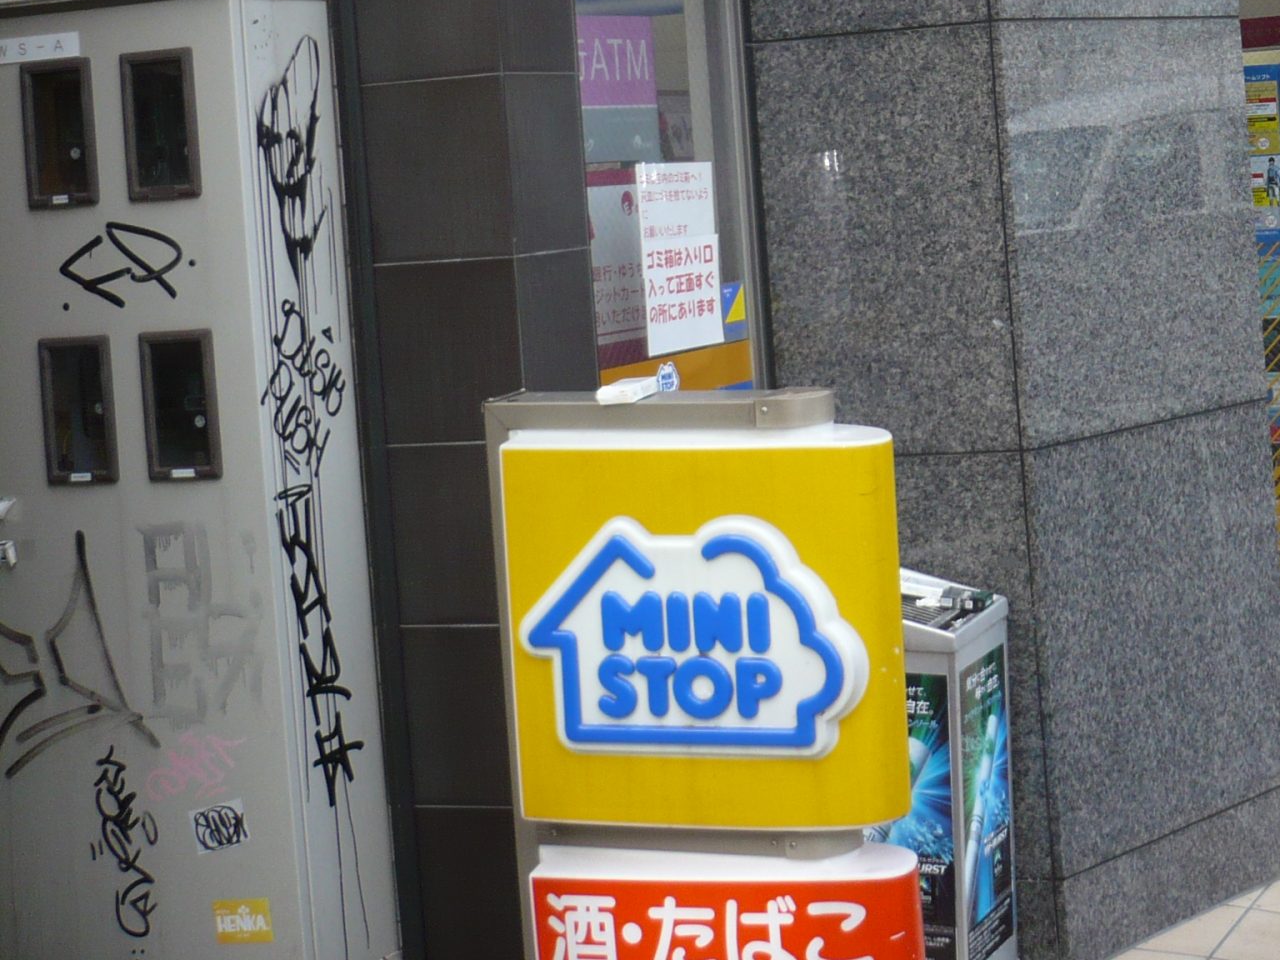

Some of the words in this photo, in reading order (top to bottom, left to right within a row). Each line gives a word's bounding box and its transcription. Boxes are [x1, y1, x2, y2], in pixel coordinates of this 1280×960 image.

[647, 244, 714, 270] ゴミ箱は入り口
[648, 270, 714, 299] 入って正面すぐ
[649, 297, 716, 324] の所にあります
[601, 590, 771, 653] MINI
[598, 654, 783, 721] STOP
[546, 894, 876, 960] 酒・たばこ
